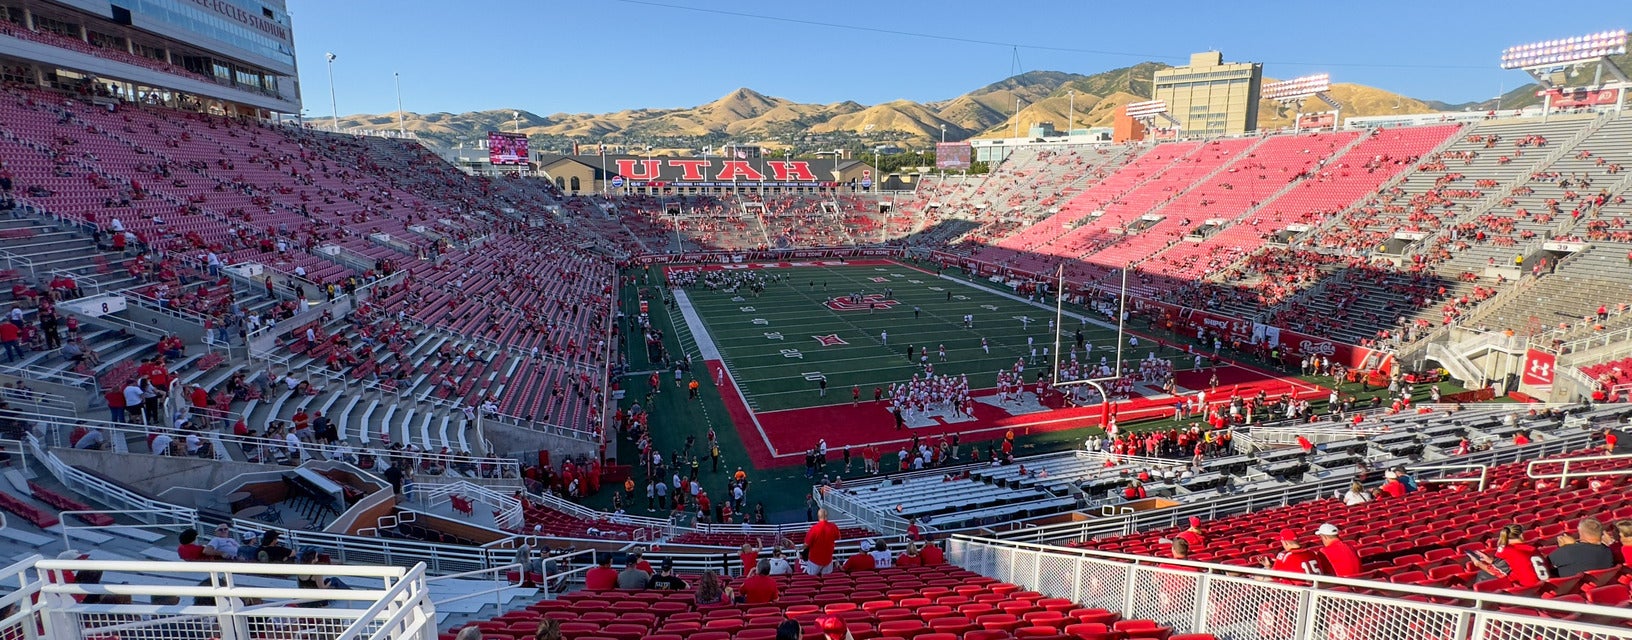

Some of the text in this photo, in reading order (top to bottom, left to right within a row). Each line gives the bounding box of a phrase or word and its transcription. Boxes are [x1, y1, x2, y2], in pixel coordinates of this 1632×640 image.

[192, 0, 286, 40] E-ECCLES STADIUM
[615, 159, 818, 181] UTAH
[102, 302, 109, 313] 8
[1301, 560, 1321, 575] 15
[1530, 555, 1549, 580] 6
